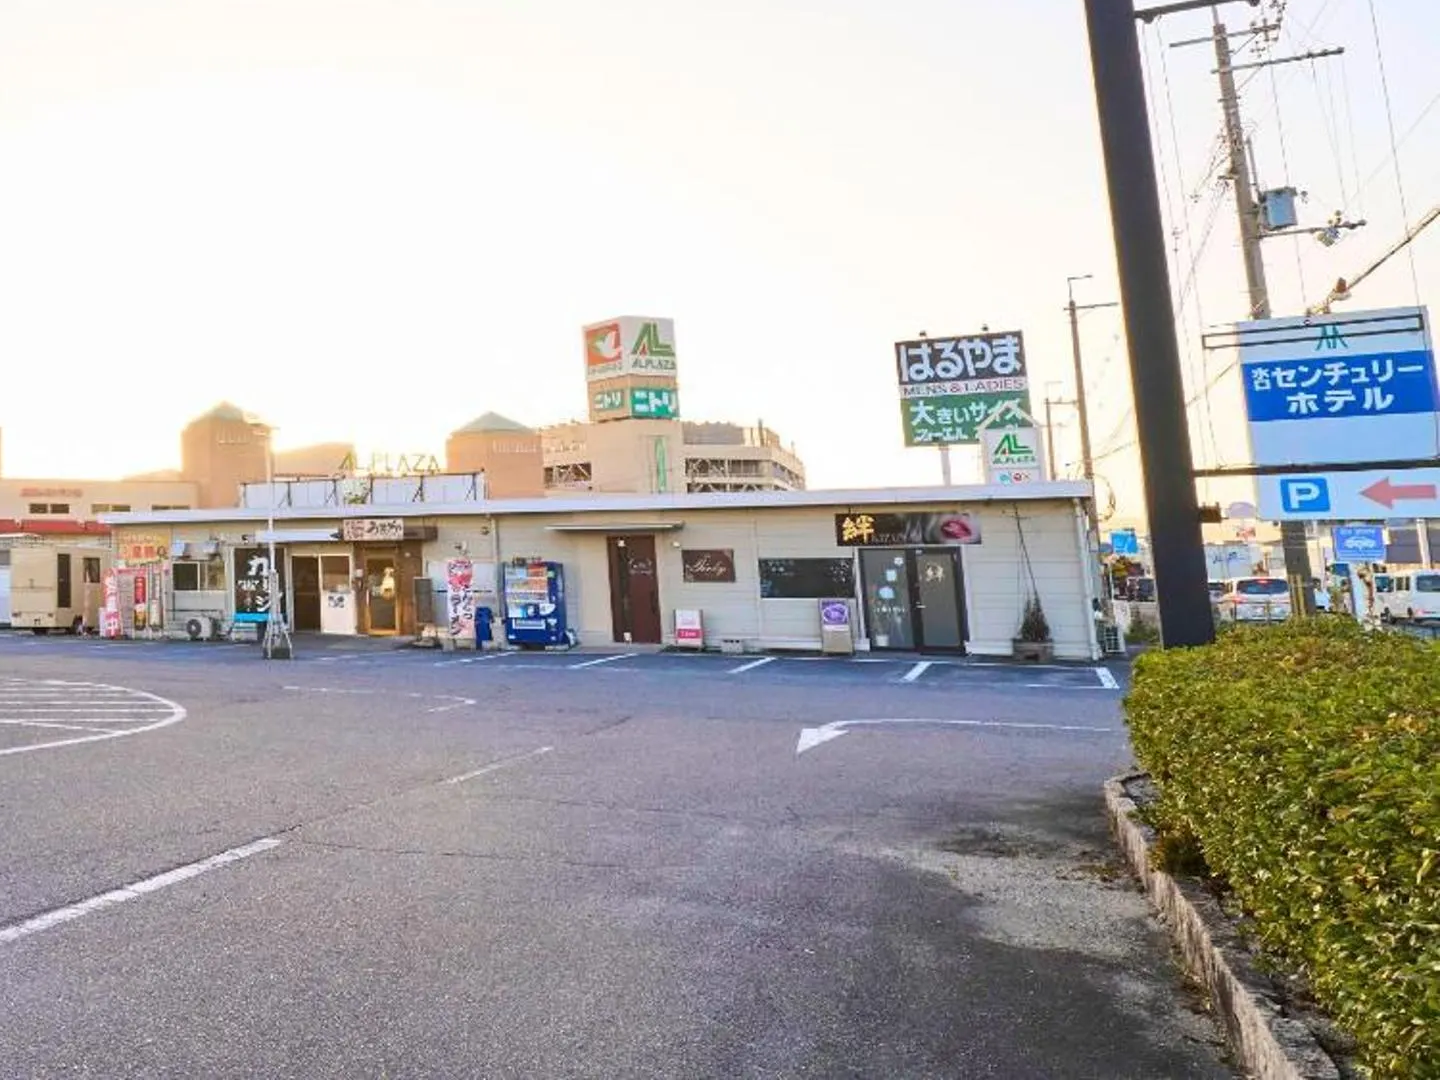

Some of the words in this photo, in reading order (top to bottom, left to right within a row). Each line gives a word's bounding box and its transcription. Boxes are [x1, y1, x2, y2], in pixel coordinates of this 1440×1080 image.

[899, 334, 1022, 381] はるやま
[903, 385, 948, 396] MENS
[964, 379, 1024, 392] LADIES
[1286, 386, 1395, 414] ホテル
[634, 390, 677, 414] ニトリ
[1287, 481, 1320, 510] P
